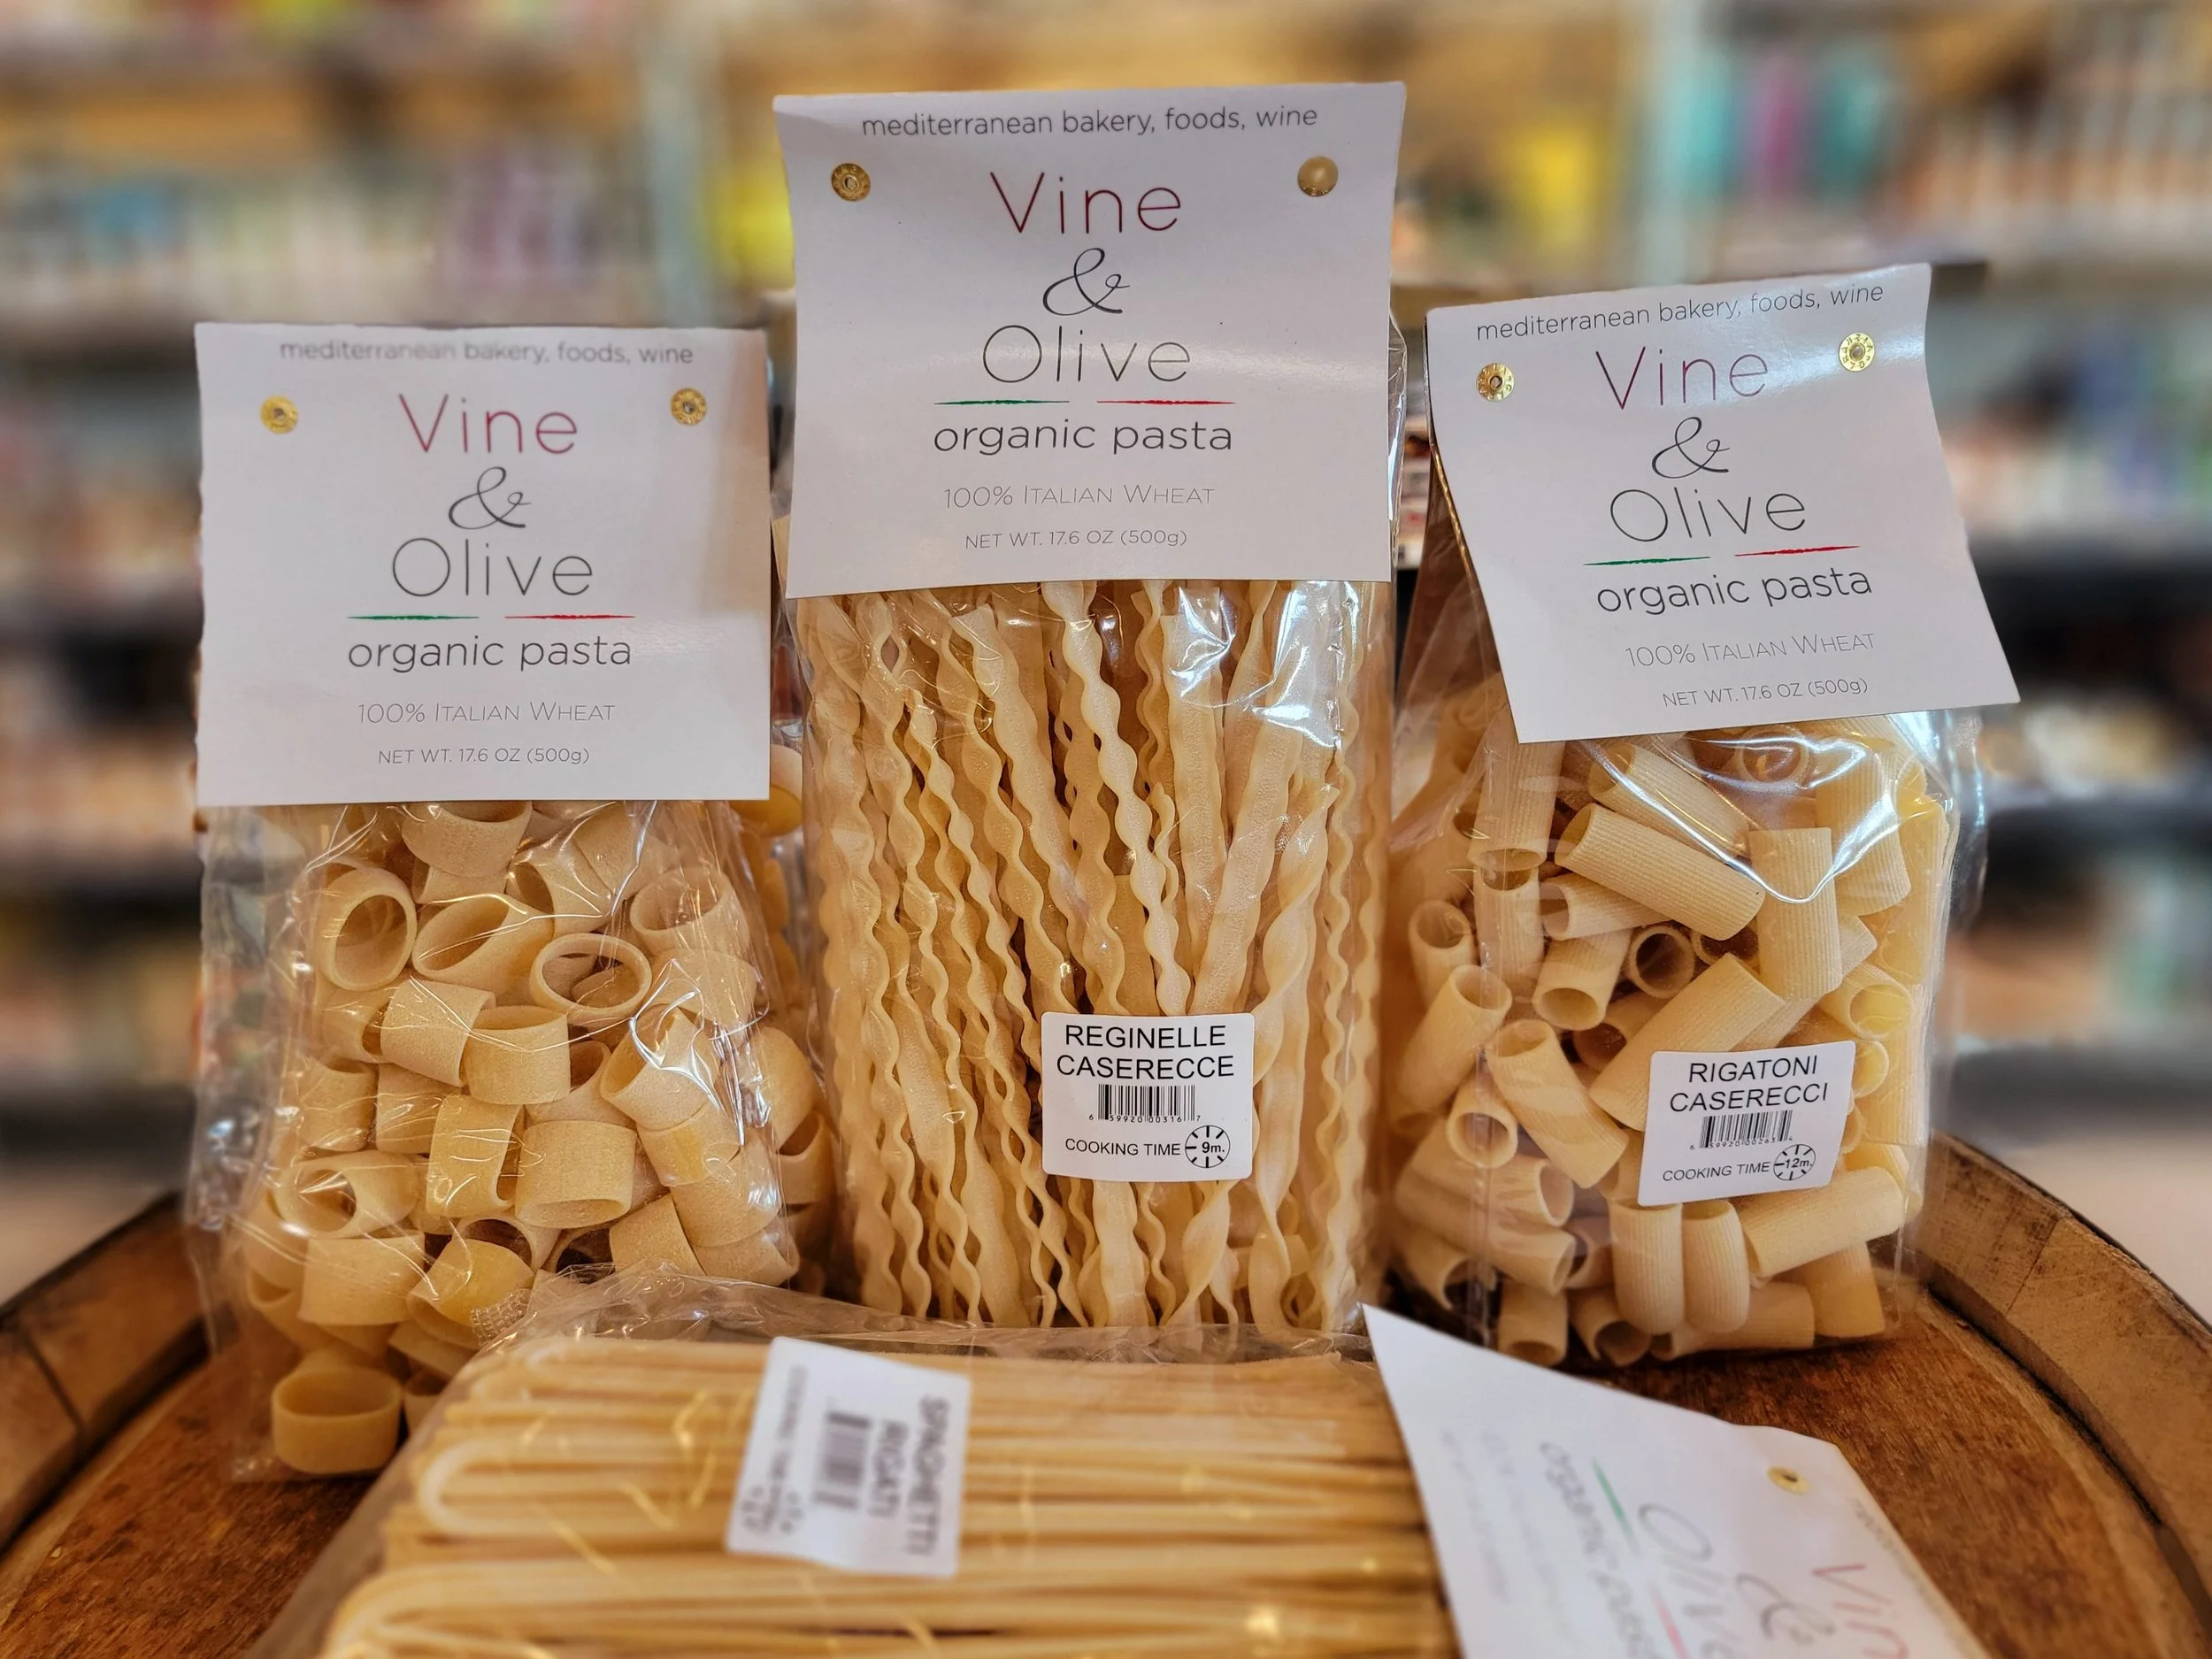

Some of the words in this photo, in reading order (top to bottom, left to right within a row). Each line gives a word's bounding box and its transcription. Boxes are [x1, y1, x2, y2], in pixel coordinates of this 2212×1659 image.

[863, 113, 1052, 135] mediterranean
[1064, 110, 1154, 135] bakery,
[1165, 106, 1245, 130] foods,
[1256, 106, 1317, 127] wine
[990, 172, 1180, 234] Vine
[1043, 248, 1130, 316] &
[1478, 310, 1649, 340] mediterranean
[1660, 299, 1740, 322] bakery,
[1751, 289, 1819, 312] foods,
[1831, 284, 1883, 304] wine
[280, 340, 456, 360] mediterranean
[464, 342, 549, 365] bakery,
[557, 342, 631, 365] foods,
[639, 349, 693, 364] wine
[983, 325, 1190, 383] Olive
[1595, 347, 1768, 410] Vine
[399, 394, 577, 454] Vine
[934, 419, 1094, 456] organic
[1114, 422, 1231, 455] pasta
[1652, 417, 1730, 479] &
[449, 467, 530, 529] &
[945, 487, 1012, 508] 100%
[1610, 487, 1805, 541] Olive
[966, 534, 1002, 549] NET
[1010, 532, 1041, 546] WT.
[1049, 531, 1079, 545] 17.6
[1087, 530, 1114, 543] OZ
[1121, 530, 1187, 546] (500g)
[393, 538, 592, 597] Olive
[1598, 575, 1749, 615] organic
[1762, 568, 1871, 607] pasta
[349, 635, 503, 673] organic
[521, 636, 630, 672] pasta
[1625, 644, 1695, 666] 100%
[1663, 691, 1697, 707] NET
[1704, 688, 1738, 703] WT.
[1741, 686, 1771, 700] 17.6
[1778, 683, 1803, 697] OZ
[1809, 678, 1867, 697] (500g)
[358, 703, 425, 723] 100%
[379, 750, 414, 764] NET
[421, 749, 451, 763] WT.
[459, 749, 488, 762] 17.6
[495, 749, 520, 762] OZ
[527, 749, 588, 764] (500g)
[1066, 1025, 1225, 1048] REGINELLE
[1057, 1055, 1233, 1079] CASERECCE
[1688, 1055, 1818, 1083] RIGATONI
[1670, 1082, 1828, 1113] CASERECCI
[1065, 1139, 1138, 1156] COOKING
[1144, 1143, 1180, 1156] TIME
[1663, 1165, 1732, 1181] COOKING
[1738, 1162, 1770, 1174] TIME
